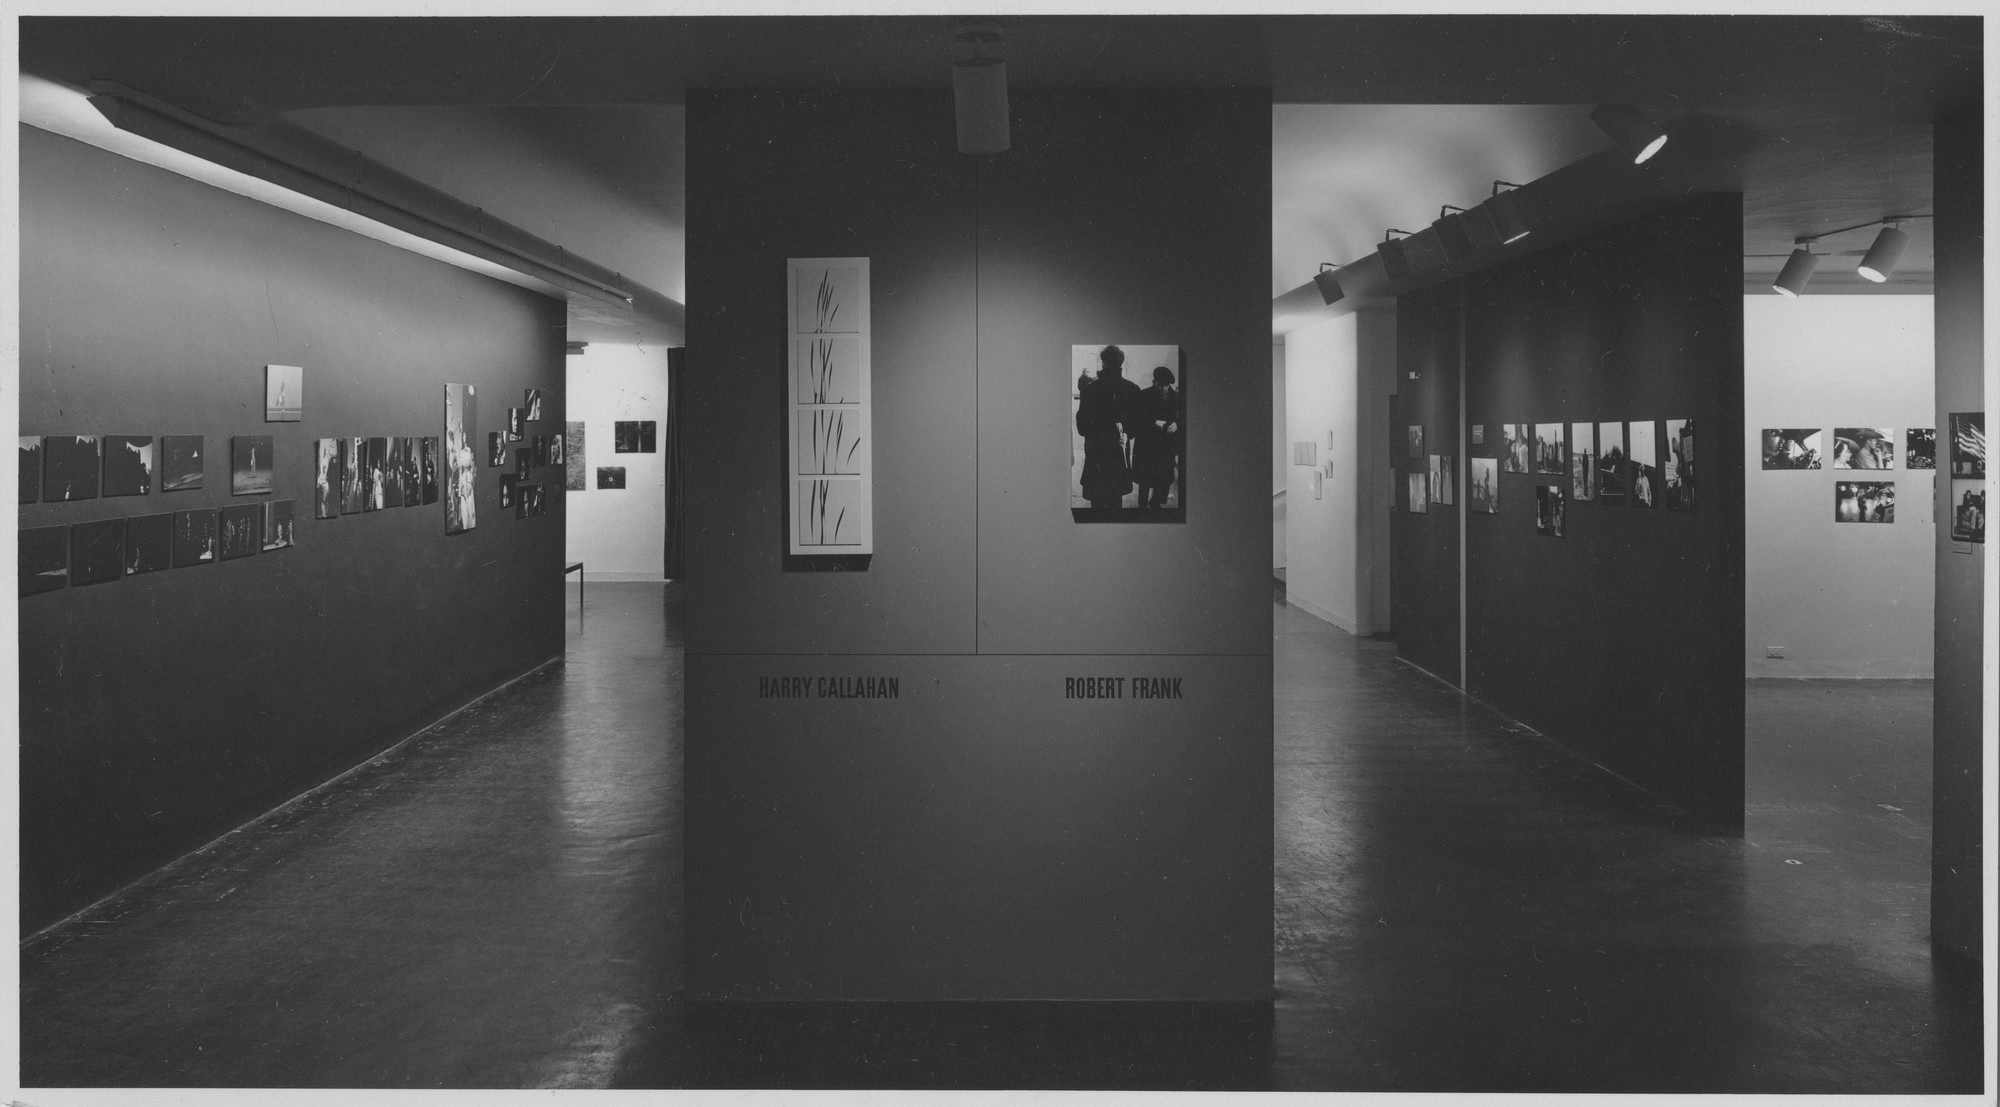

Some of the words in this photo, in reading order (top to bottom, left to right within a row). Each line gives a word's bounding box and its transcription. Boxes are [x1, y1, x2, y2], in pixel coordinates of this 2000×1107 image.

[759, 676, 812, 699] HARRY
[818, 676, 899, 699] CALLAHAN
[1065, 677, 1123, 699] ROBERT
[1132, 677, 1183, 699] FRANK
